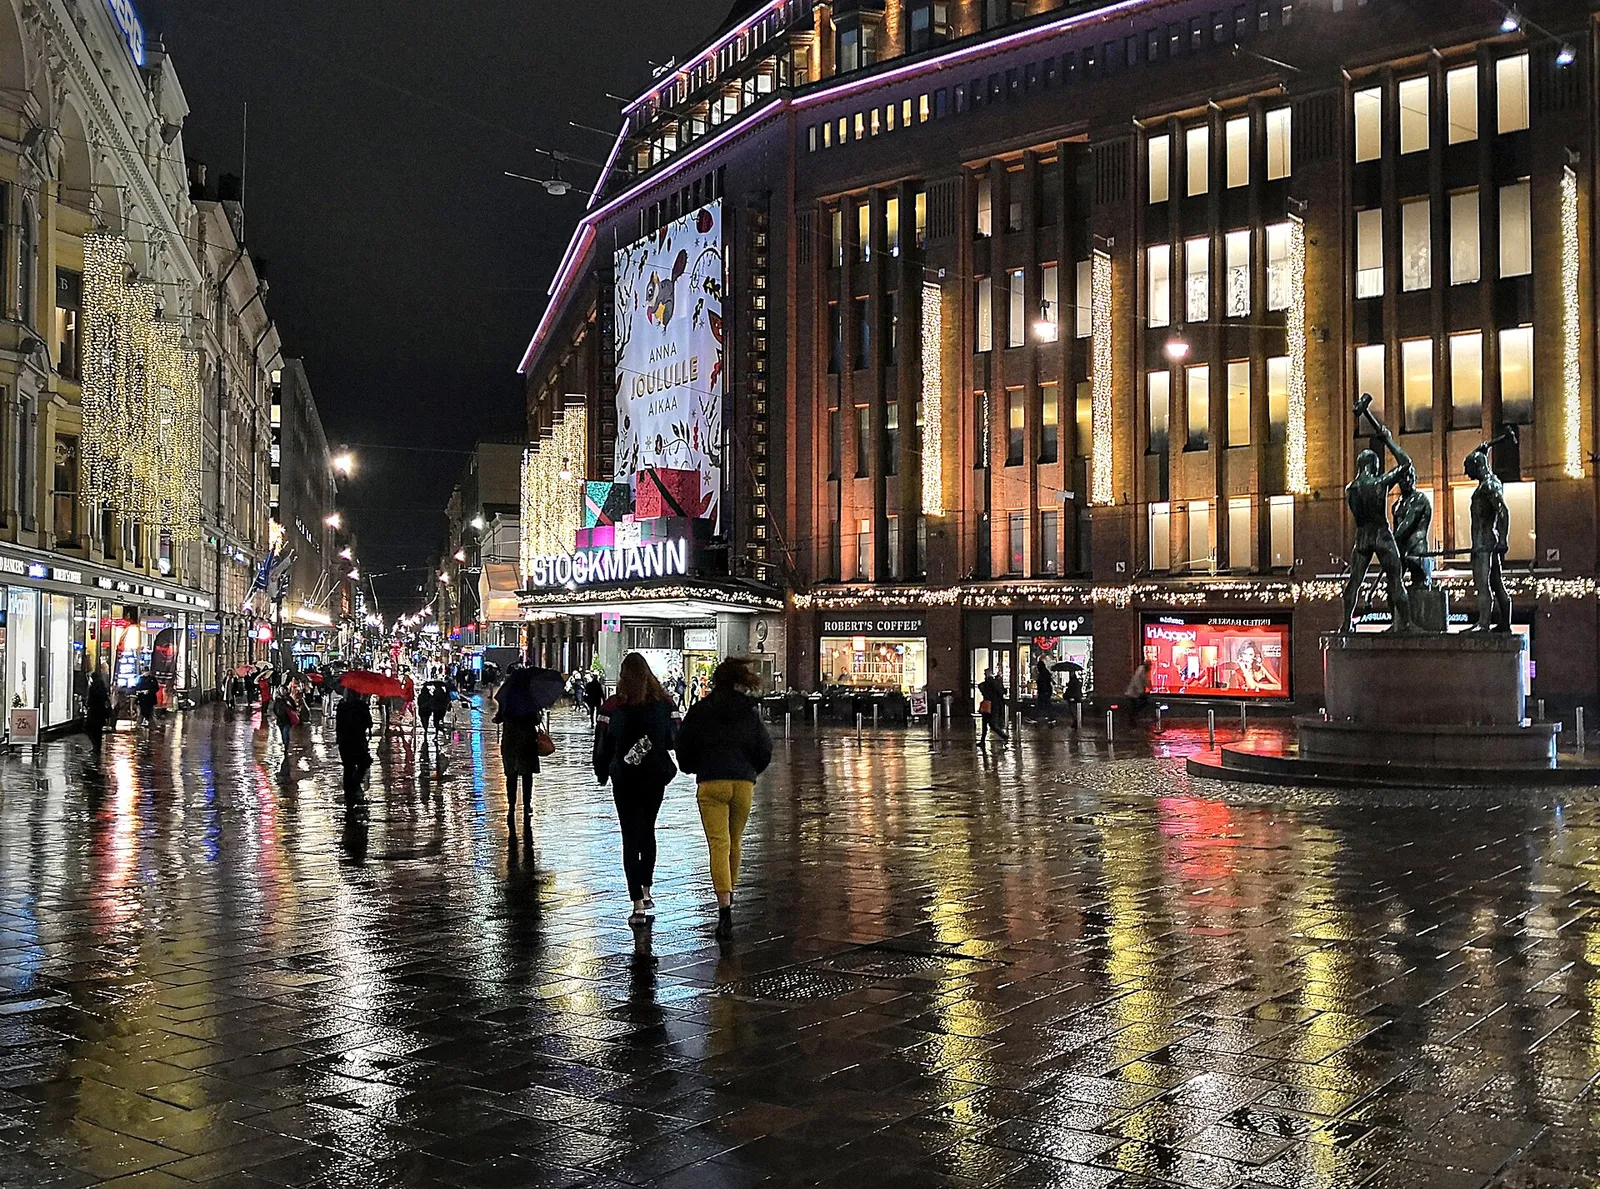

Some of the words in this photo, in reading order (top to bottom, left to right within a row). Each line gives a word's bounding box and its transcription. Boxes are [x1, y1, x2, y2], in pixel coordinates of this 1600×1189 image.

[649, 341, 677, 364] ANNA
[631, 356, 698, 401] JOULULLE
[648, 395, 678, 417] AIKAA
[532, 537, 687, 586] STOCKMANN
[824, 621, 873, 632] ROBERT'S
